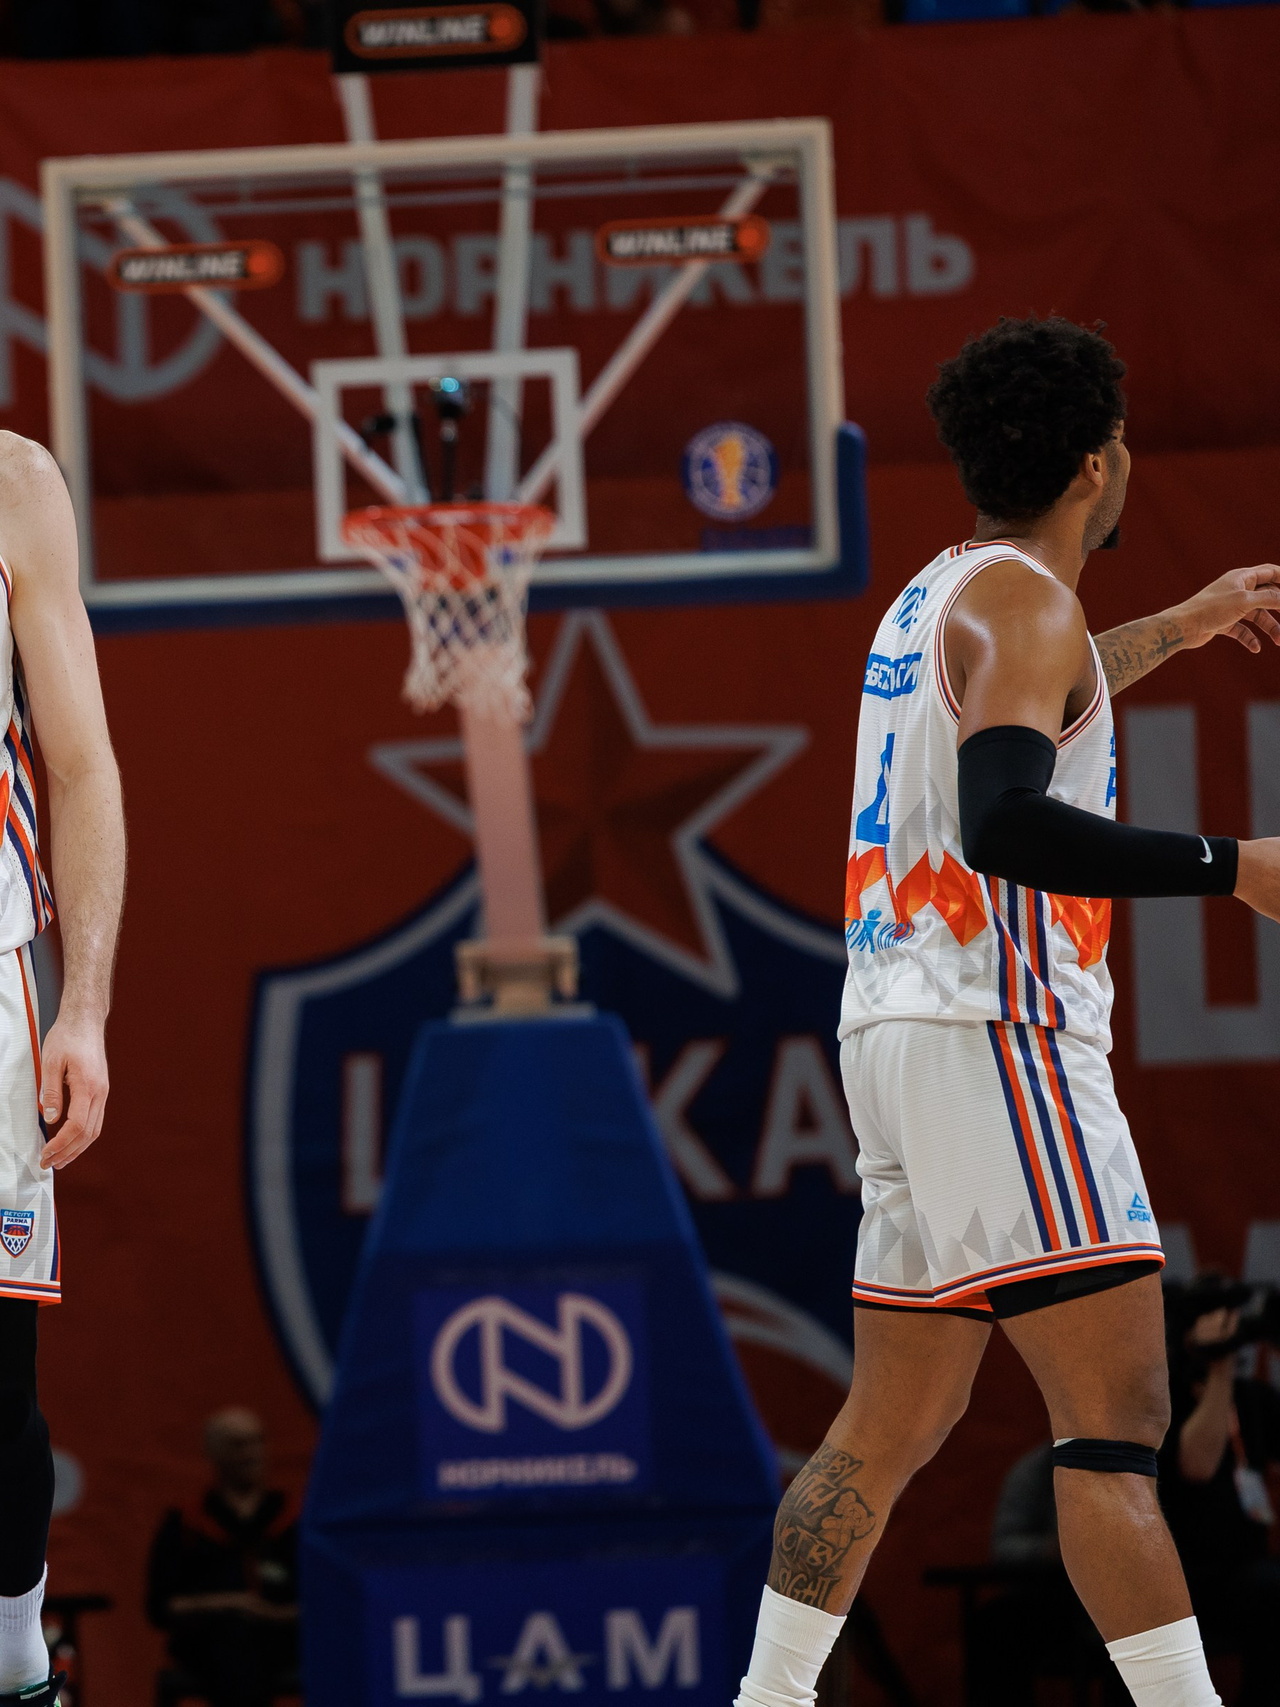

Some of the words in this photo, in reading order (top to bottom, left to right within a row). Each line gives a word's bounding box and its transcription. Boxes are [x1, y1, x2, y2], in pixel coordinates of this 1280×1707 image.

[360, 14, 487, 47] WINLINE
[610, 224, 734, 257] WINLINE
[122, 250, 239, 283] WINLINE
[4, 1210, 31, 1218] BETCITY
